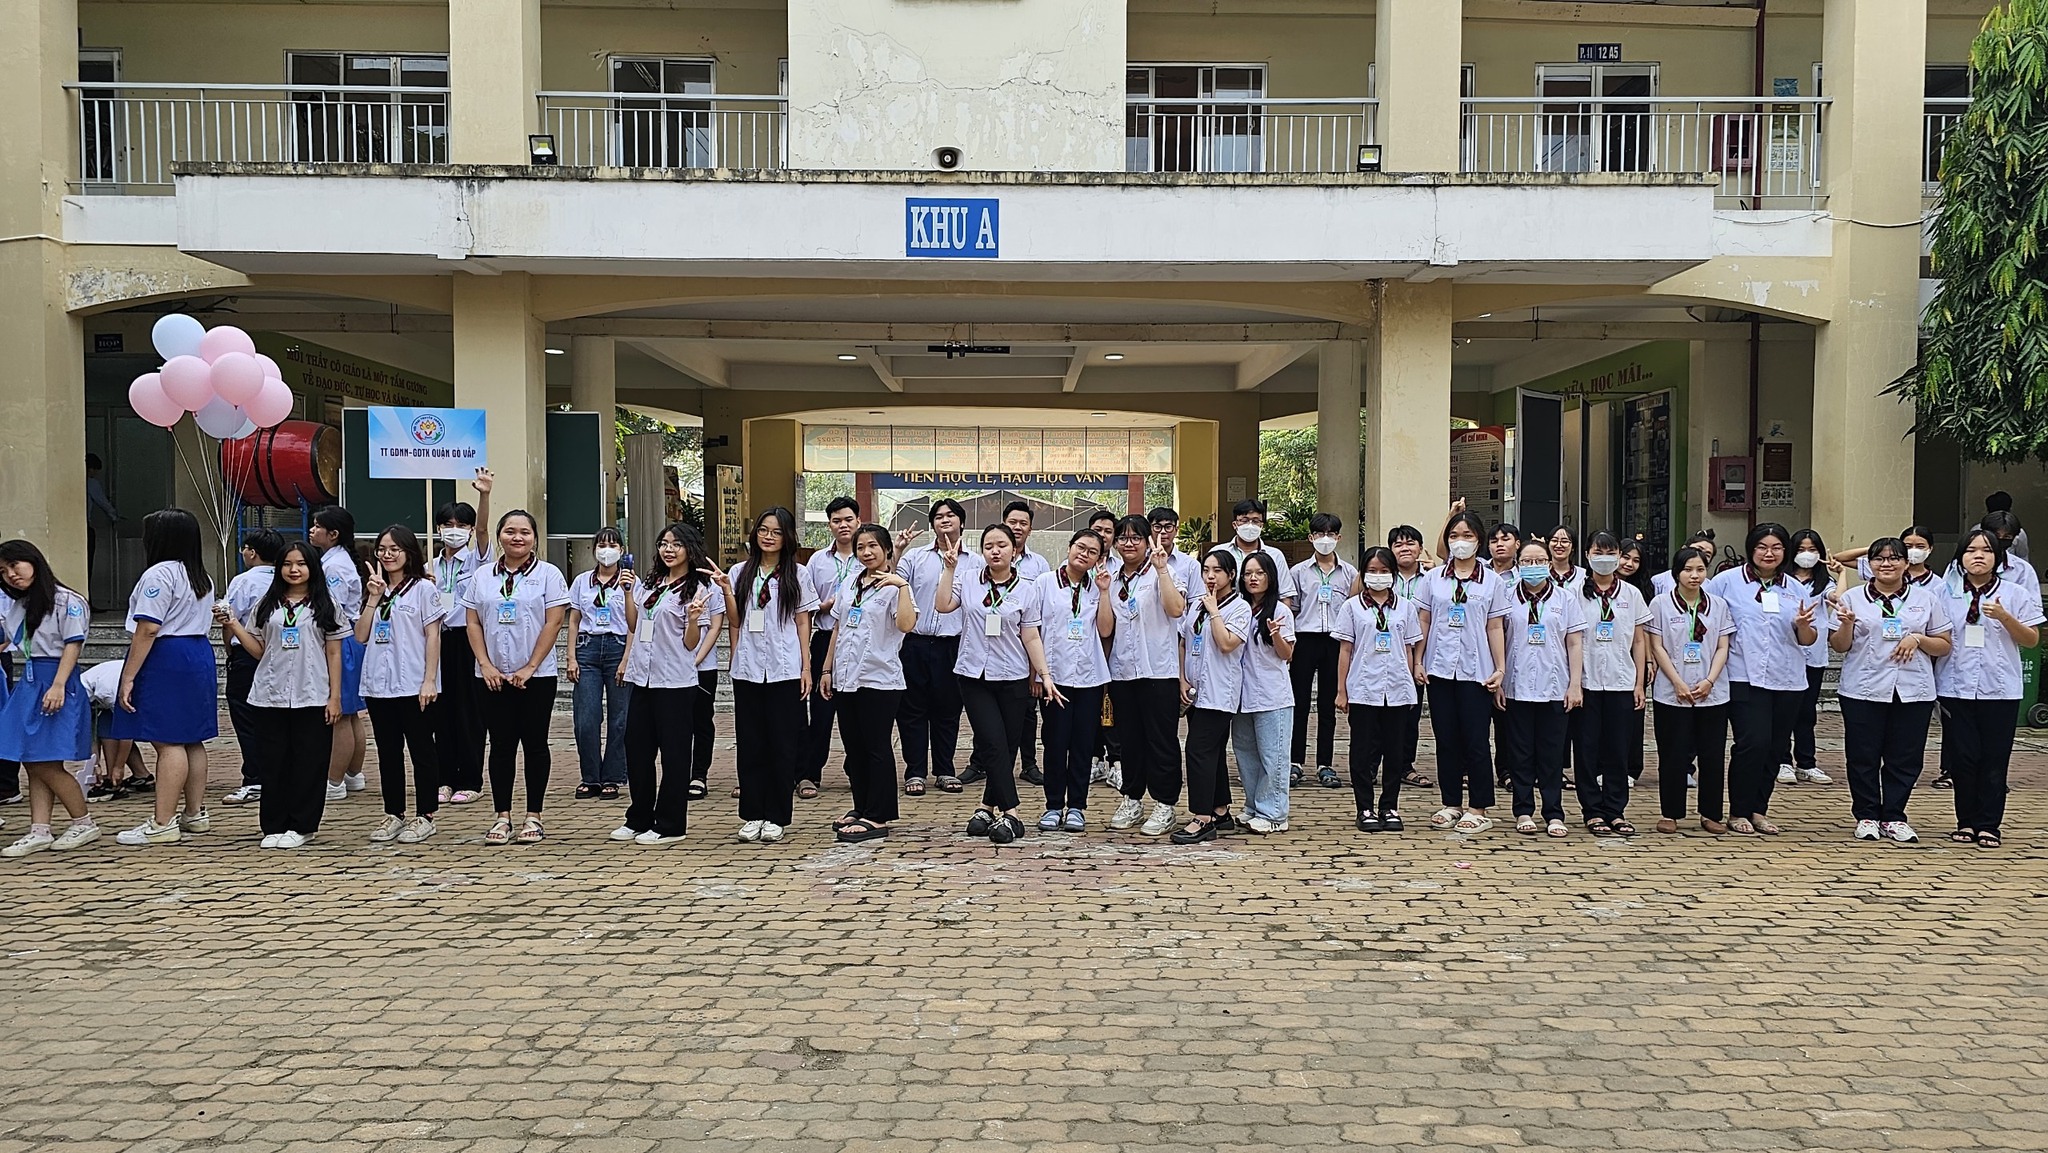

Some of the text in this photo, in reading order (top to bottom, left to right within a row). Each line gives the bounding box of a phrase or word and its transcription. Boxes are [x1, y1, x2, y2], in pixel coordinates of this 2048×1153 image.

[910, 206, 996, 250] KHU A
[380, 447, 389, 457] TT
[431, 447, 450, 460] QUẬN
[451, 446, 461, 458] GÒ
[939, 472, 973, 486] HỌC
[1036, 472, 1069, 486] HỌC
